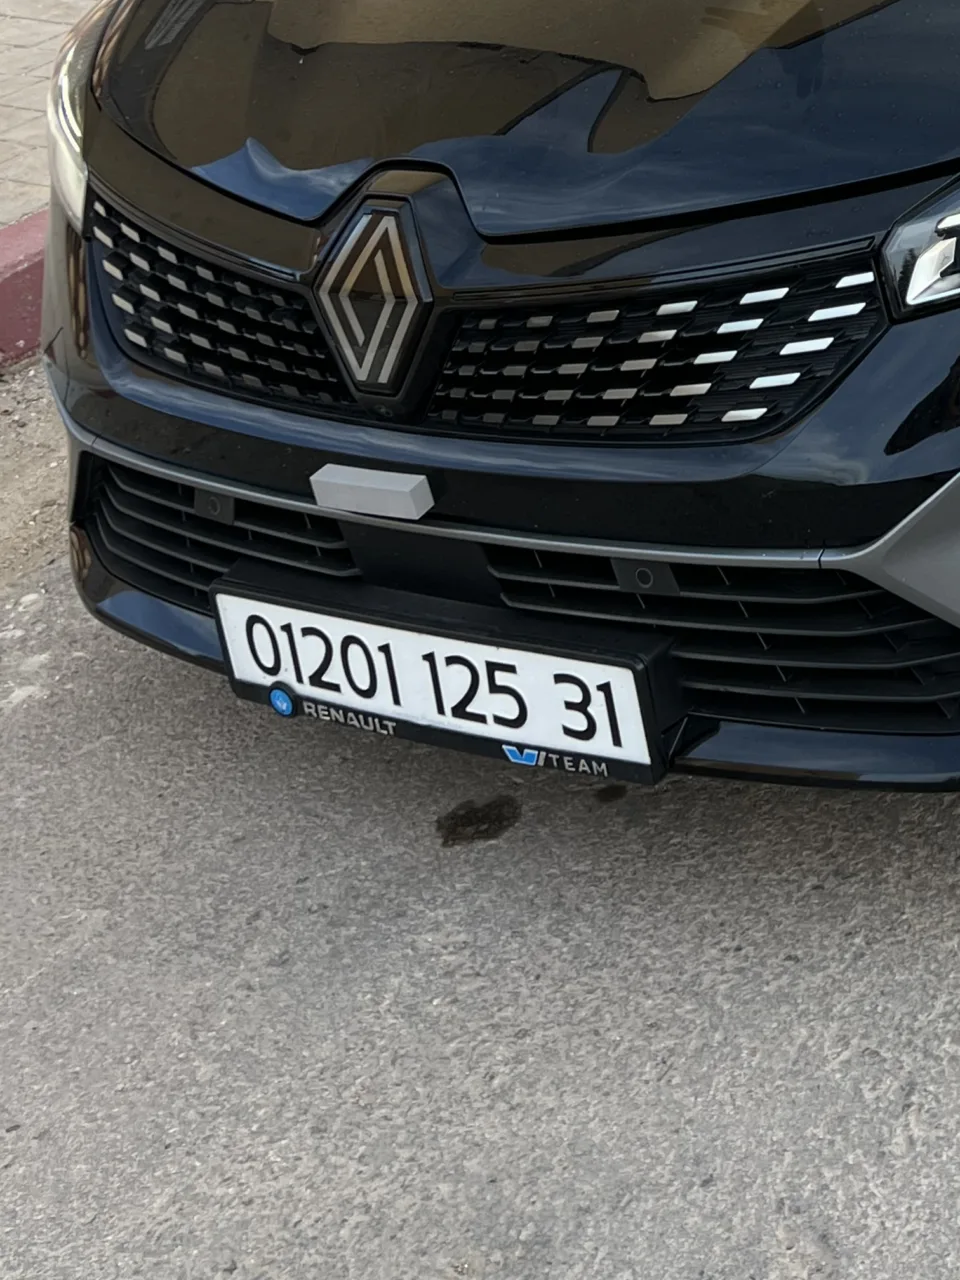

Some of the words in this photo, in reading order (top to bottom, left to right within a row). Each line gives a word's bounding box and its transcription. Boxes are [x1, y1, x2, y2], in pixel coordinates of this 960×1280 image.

[245, 613, 402, 707] 01201
[421, 650, 528, 729] 125
[553, 672, 623, 749] 31
[302, 700, 397, 736] RENAULT
